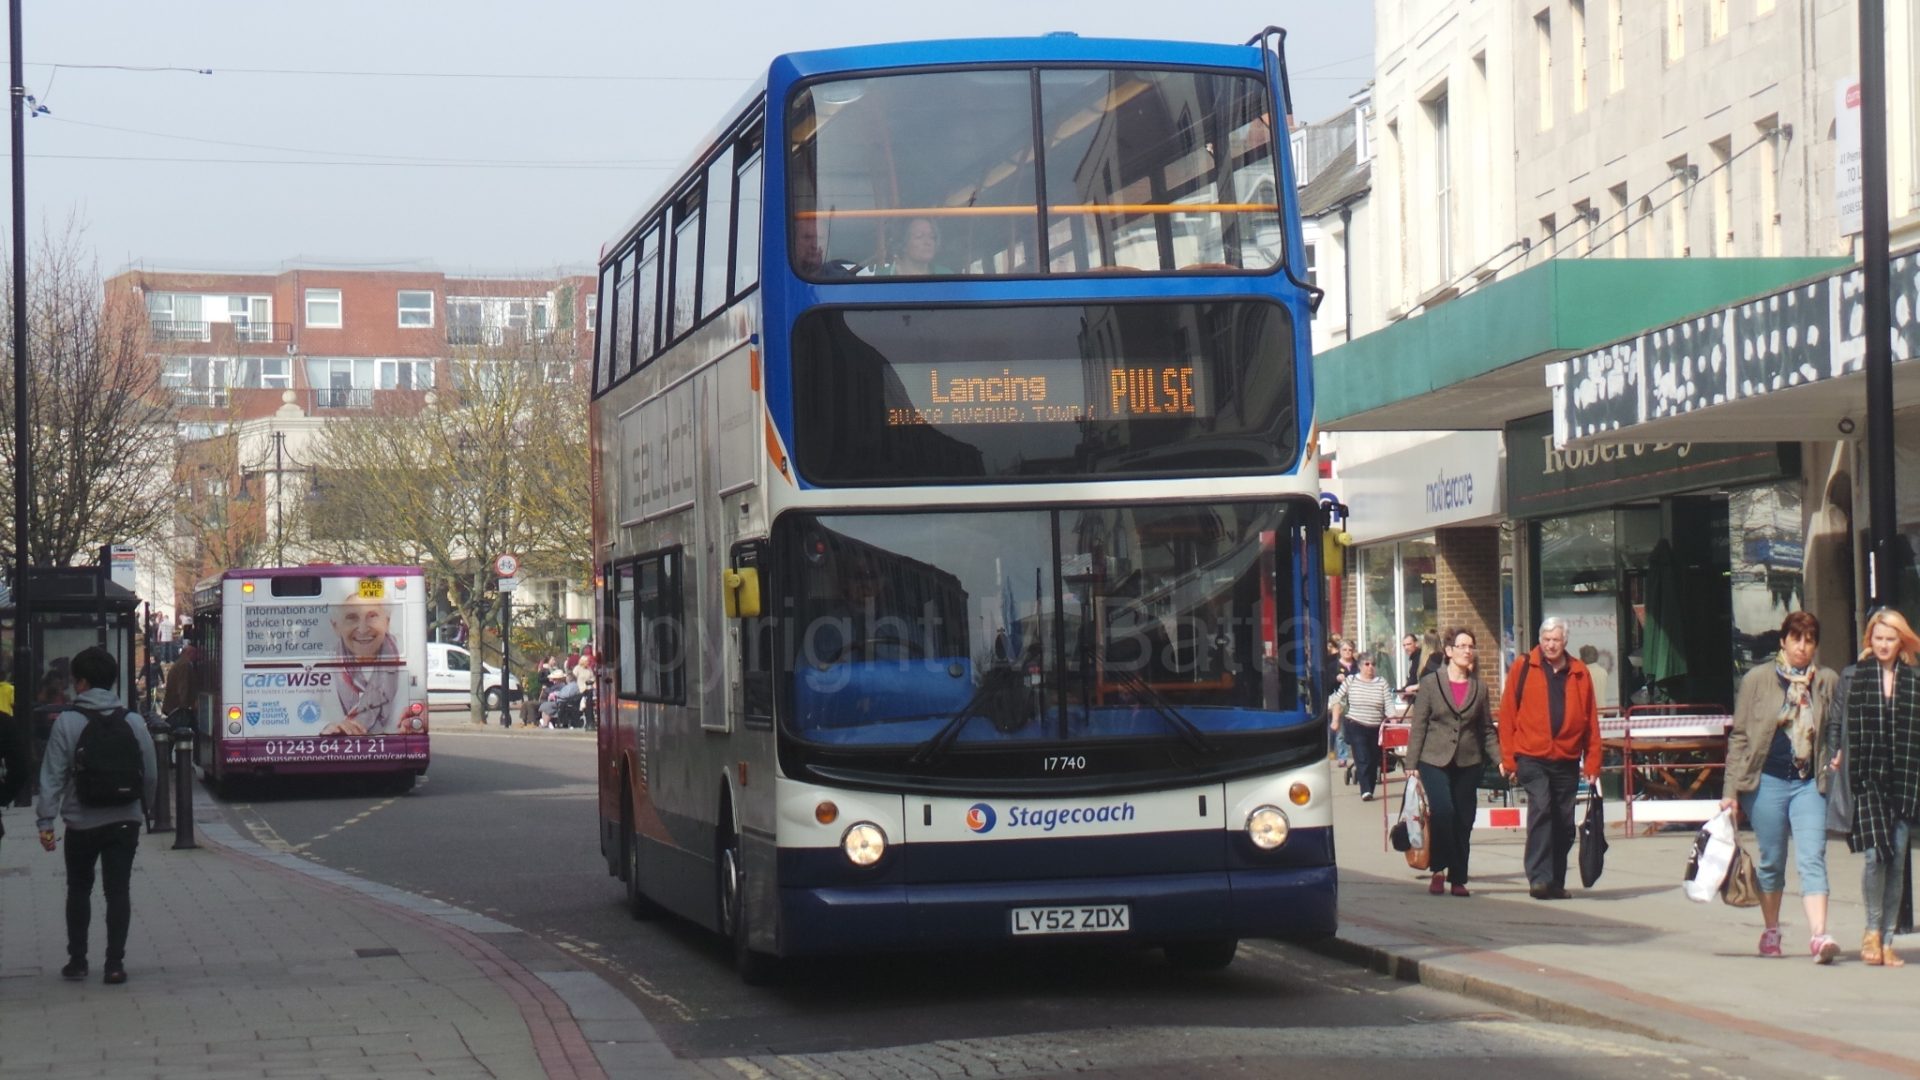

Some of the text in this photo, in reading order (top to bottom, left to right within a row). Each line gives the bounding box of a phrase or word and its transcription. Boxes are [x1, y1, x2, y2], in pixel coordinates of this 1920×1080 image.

[931, 367, 1196, 414] Lancing PULSE
[246, 603, 329, 616] Information and
[246, 617, 279, 627] advice
[282, 618, 293, 626] to
[247, 630, 264, 640] the
[299, 627, 311, 638] of
[247, 640, 324, 654] paying for care
[245, 669, 332, 688] carewise
[265, 738, 386, 755] 01243 64 21 21
[1043, 756, 1086, 771] 17740
[1007, 802, 1135, 831] Stagecoach
[1015, 907, 1125, 931] LY52 ZDX
